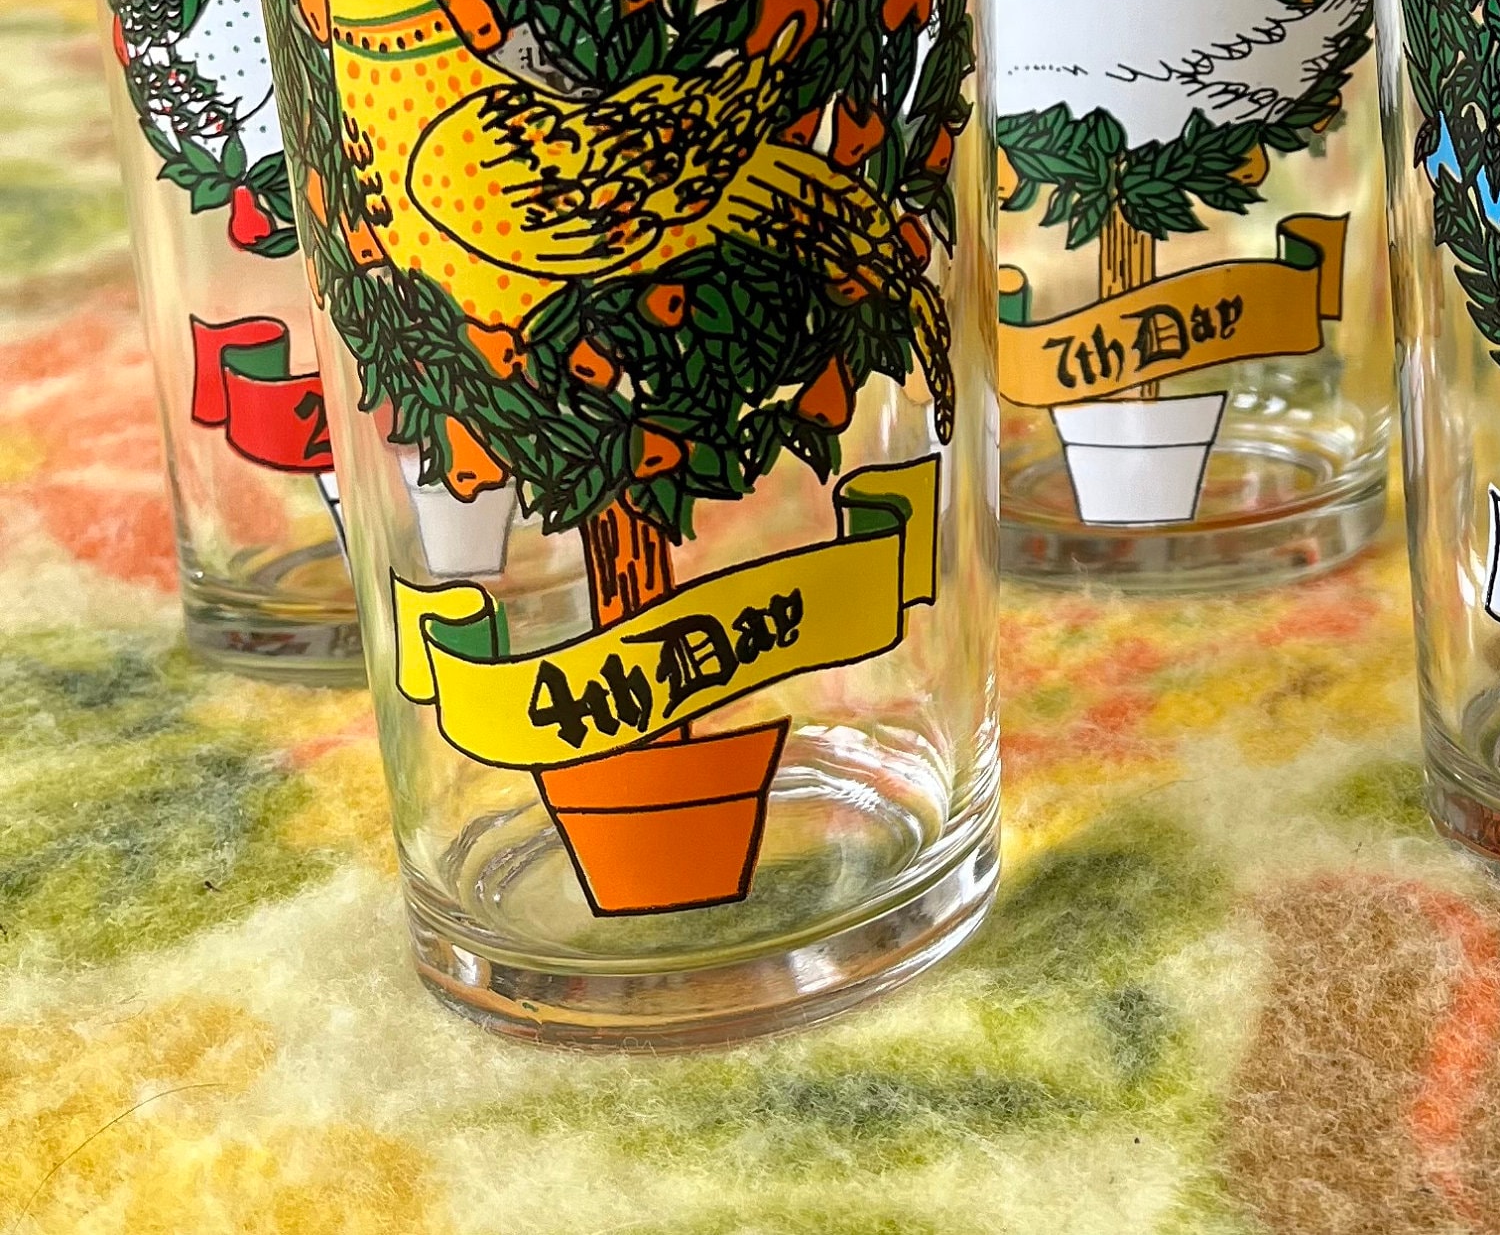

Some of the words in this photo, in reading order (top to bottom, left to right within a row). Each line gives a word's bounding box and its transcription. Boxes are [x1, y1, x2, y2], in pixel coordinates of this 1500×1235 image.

[1042, 323, 1125, 388] 7th
[1120, 295, 1243, 372] Day
[528, 653, 653, 749] 4th
[620, 587, 804, 718] Day
